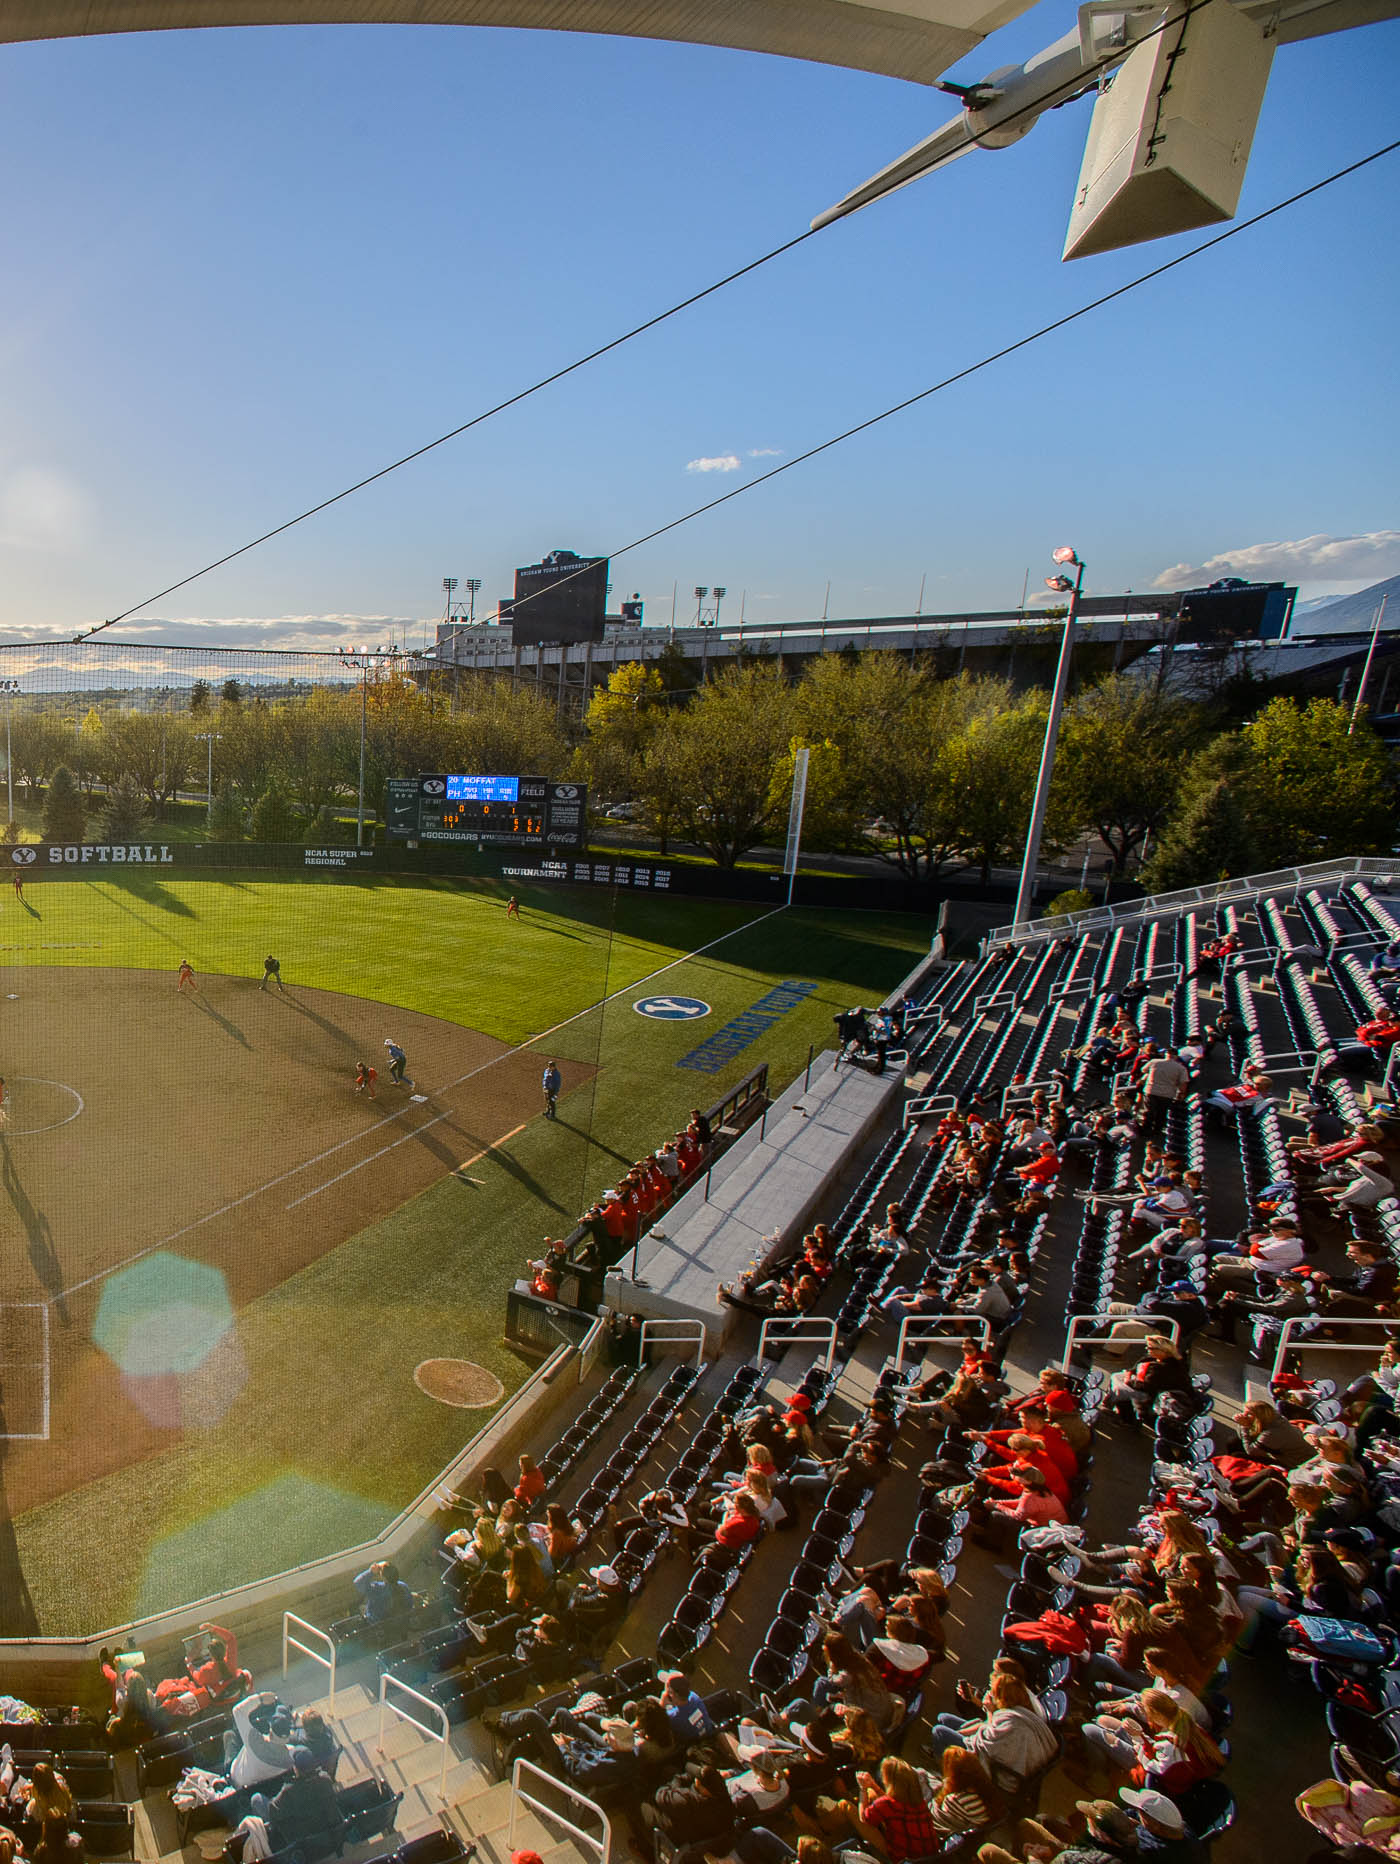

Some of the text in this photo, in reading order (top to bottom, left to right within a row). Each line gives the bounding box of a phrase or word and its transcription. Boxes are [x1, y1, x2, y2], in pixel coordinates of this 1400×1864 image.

[463, 776, 496, 784] MOFFAT
[520, 788, 545, 796] FIELD
[49, 846, 173, 863] SOFTBALL
[305, 849, 328, 857] NCAA
[329, 850, 358, 858] SUPER
[304, 857, 347, 866] REGIONAL
[541, 860, 567, 870] NCAA
[502, 867, 567, 879] TOURNAMENT
